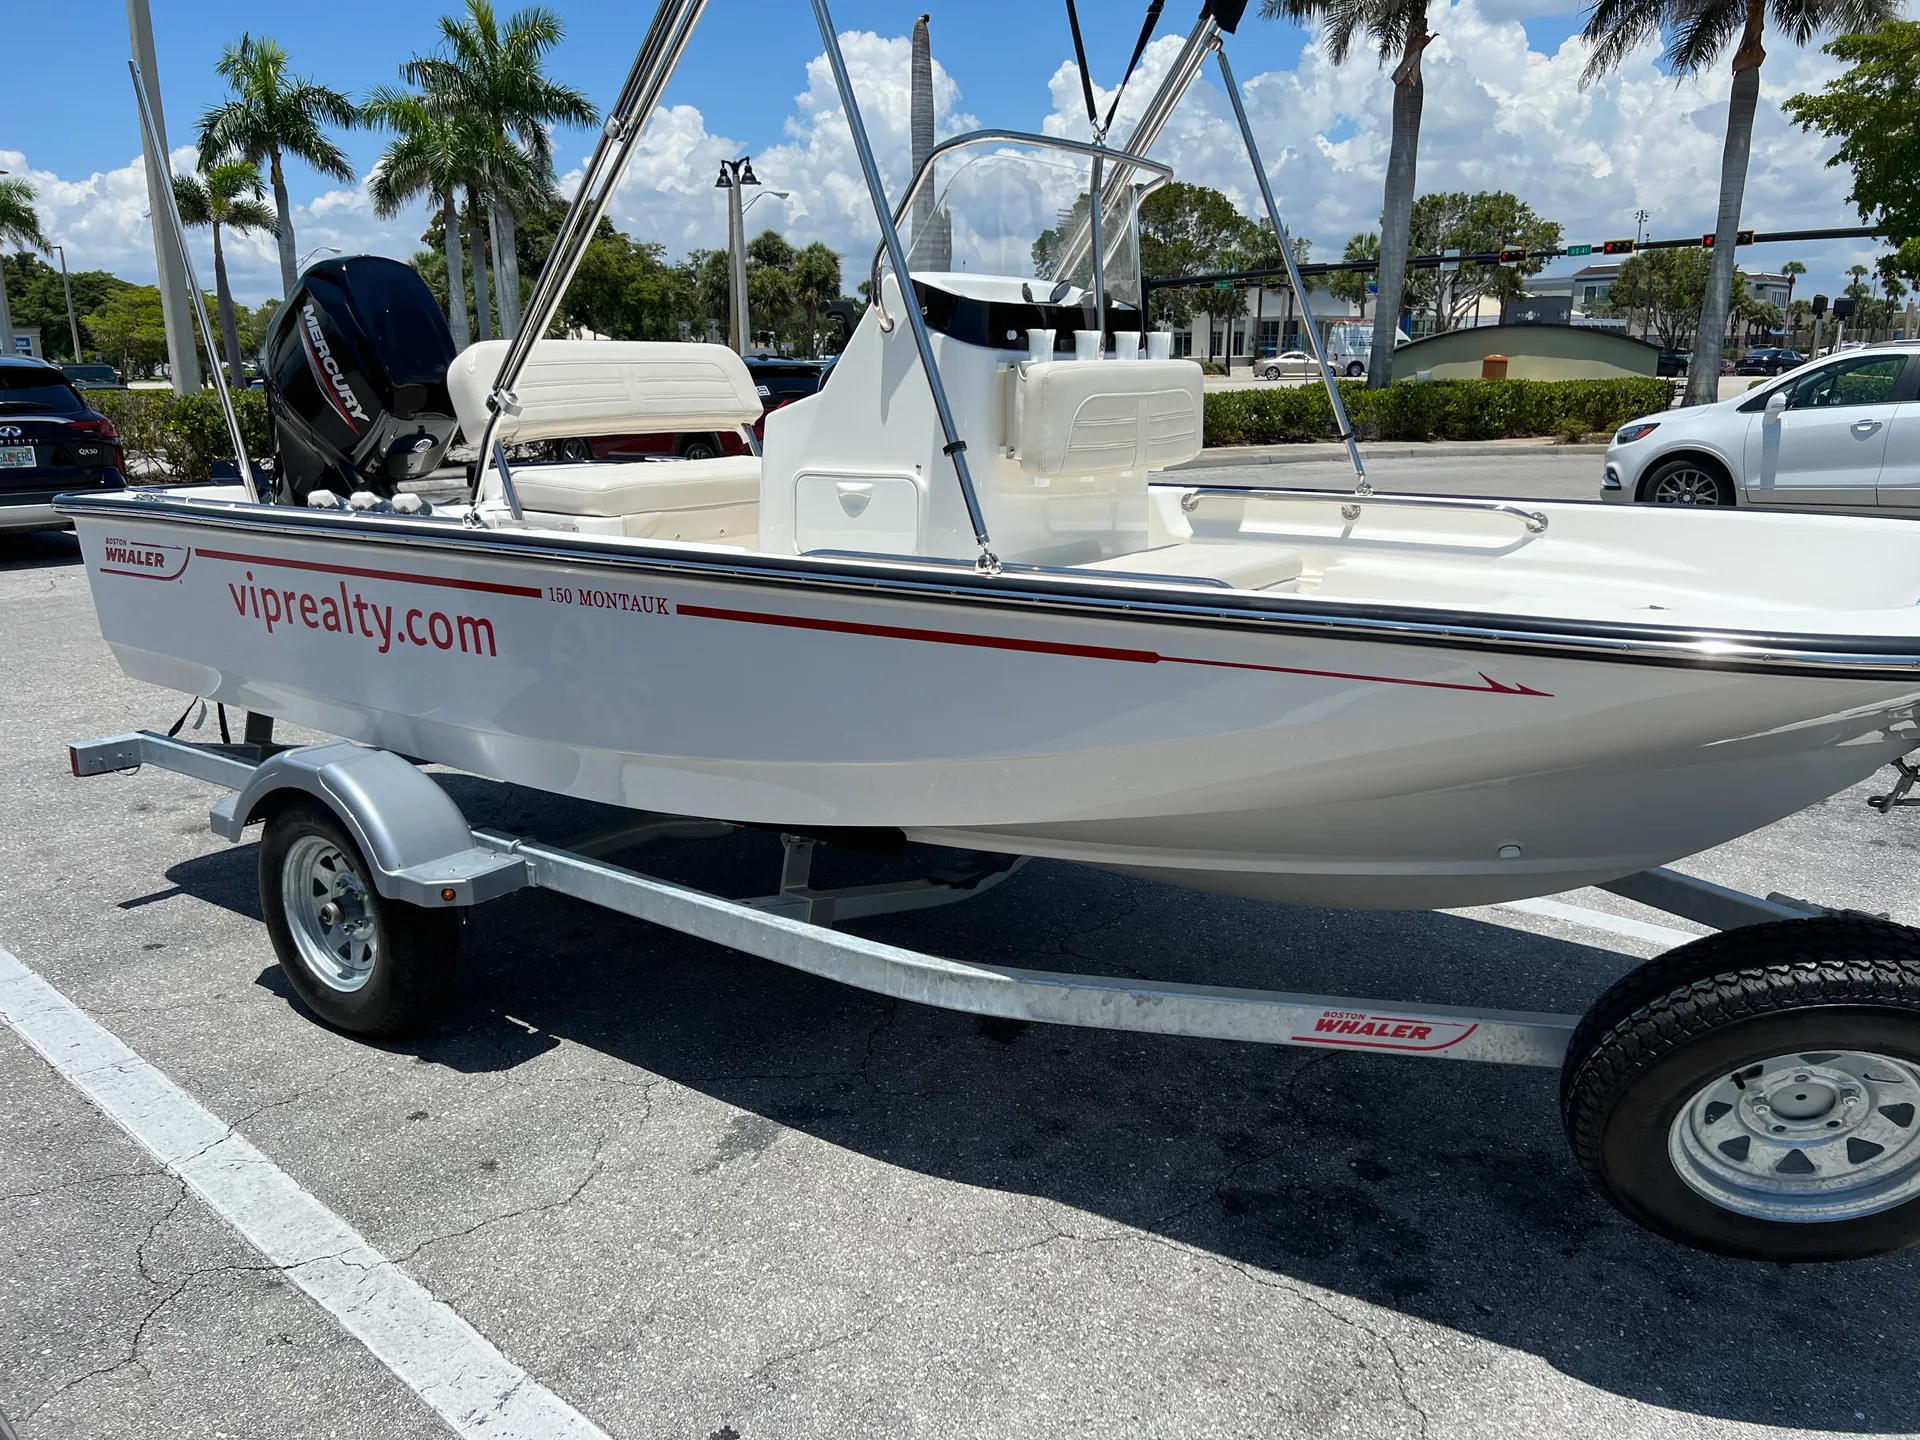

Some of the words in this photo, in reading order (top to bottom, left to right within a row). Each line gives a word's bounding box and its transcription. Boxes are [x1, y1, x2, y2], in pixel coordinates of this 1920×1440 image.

[303, 304, 370, 422] MERCURY
[78, 447, 98, 456] QX50
[105, 537, 127, 546] BOSTON
[105, 546, 165, 569] WHALER
[548, 586, 573, 604] 150
[578, 589, 670, 615] MONTAUK
[228, 571, 498, 657] viprealty.com
[1323, 1010, 1366, 1020] BOSTON
[1314, 1018, 1432, 1040] WHALER
